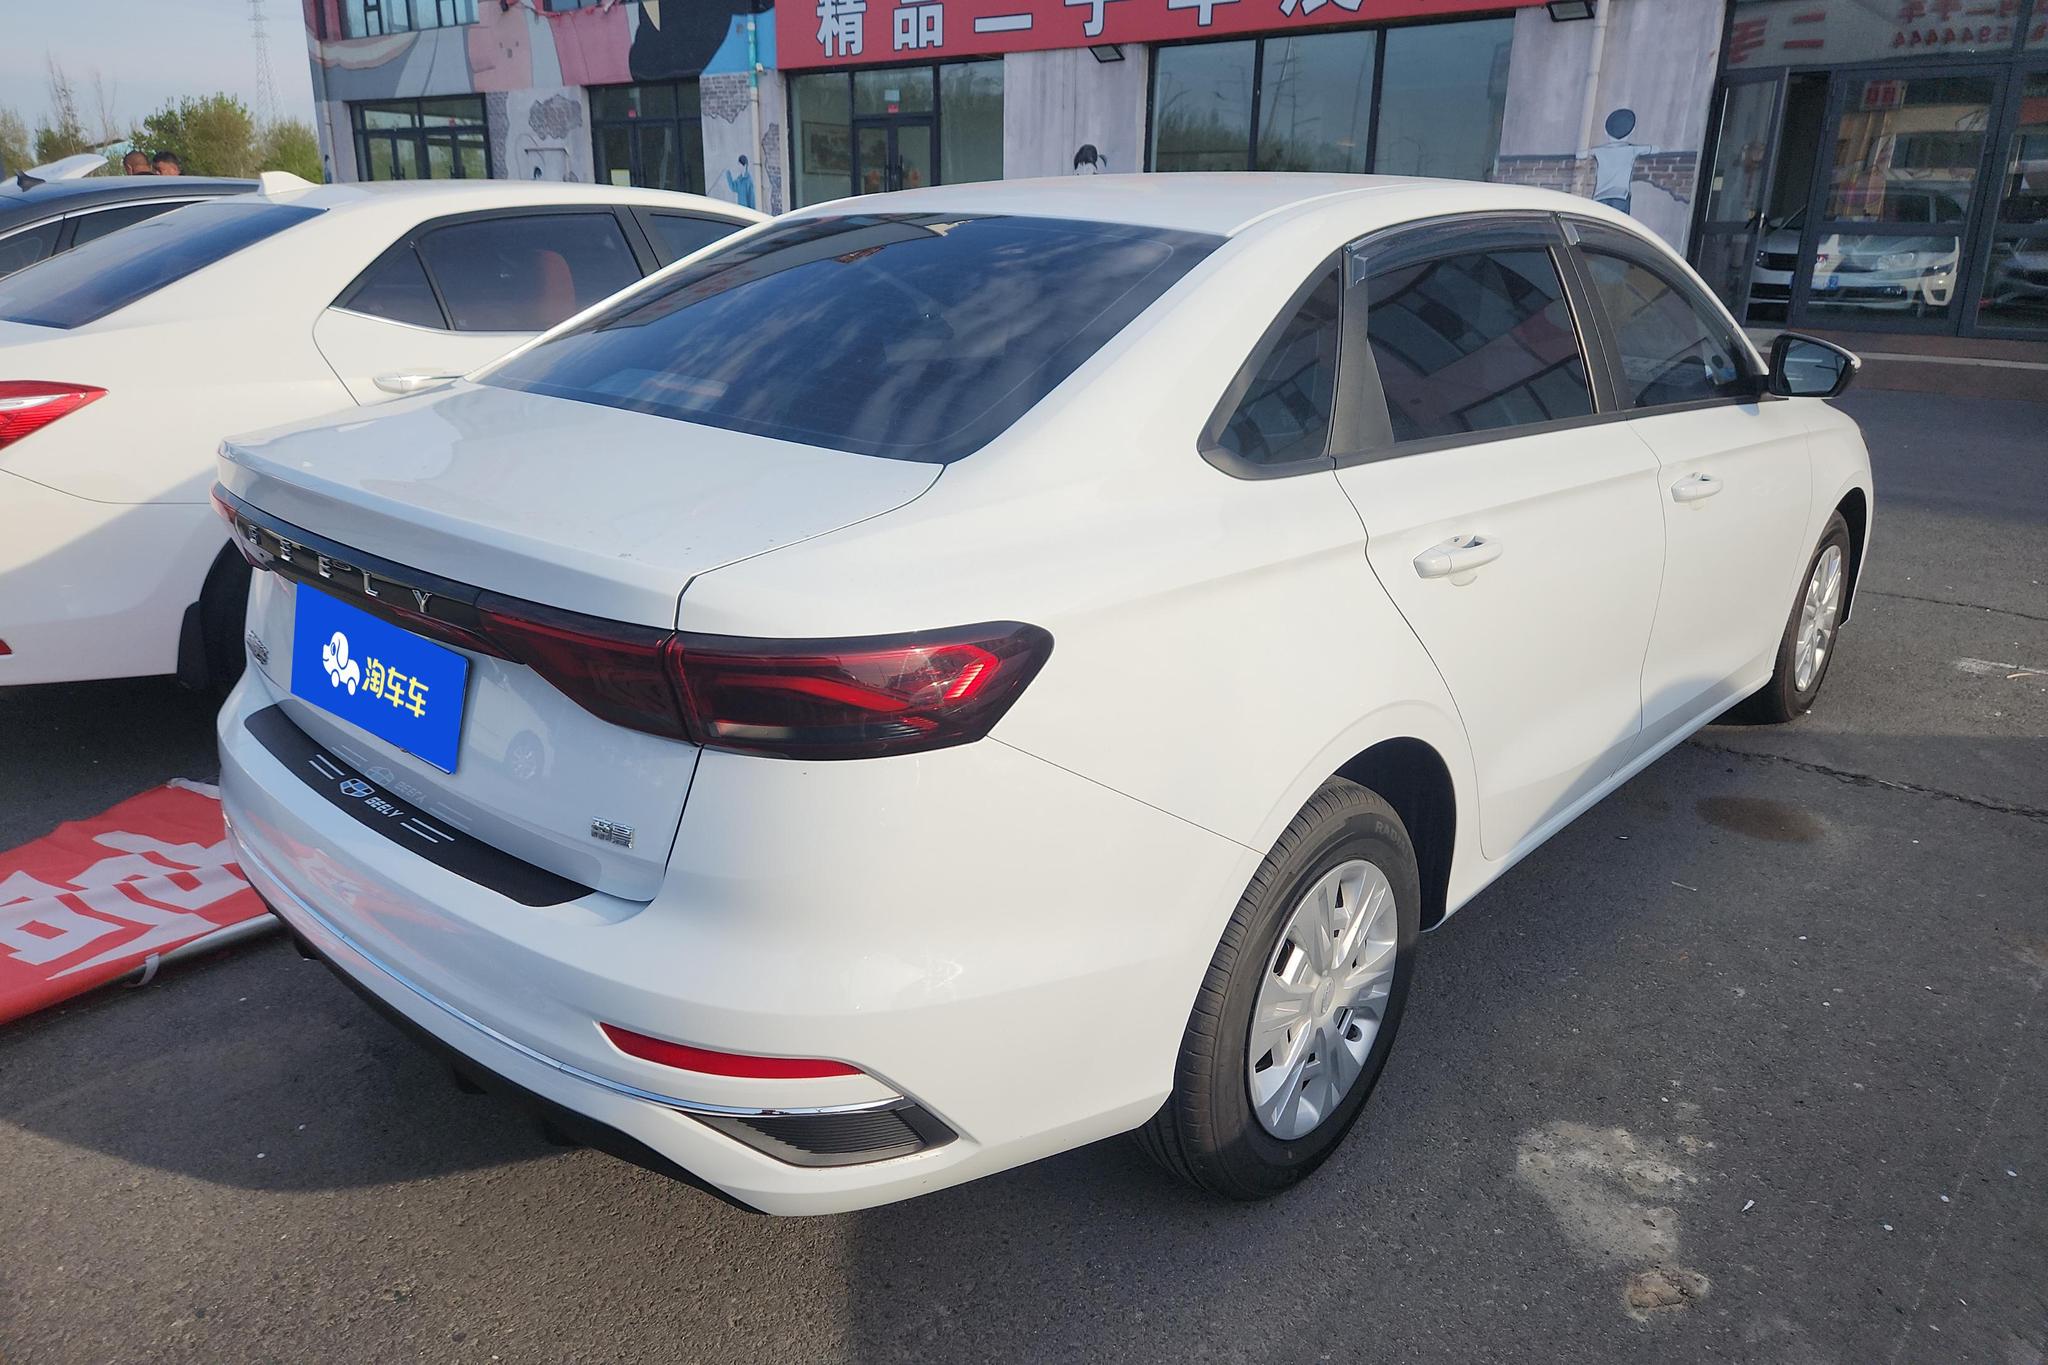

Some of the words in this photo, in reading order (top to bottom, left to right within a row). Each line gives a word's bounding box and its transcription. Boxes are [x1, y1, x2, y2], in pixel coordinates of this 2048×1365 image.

[816, 0, 1362, 58] 精品二
[249, 524, 432, 613] GEELY
[364, 797, 405, 818] GEELY
